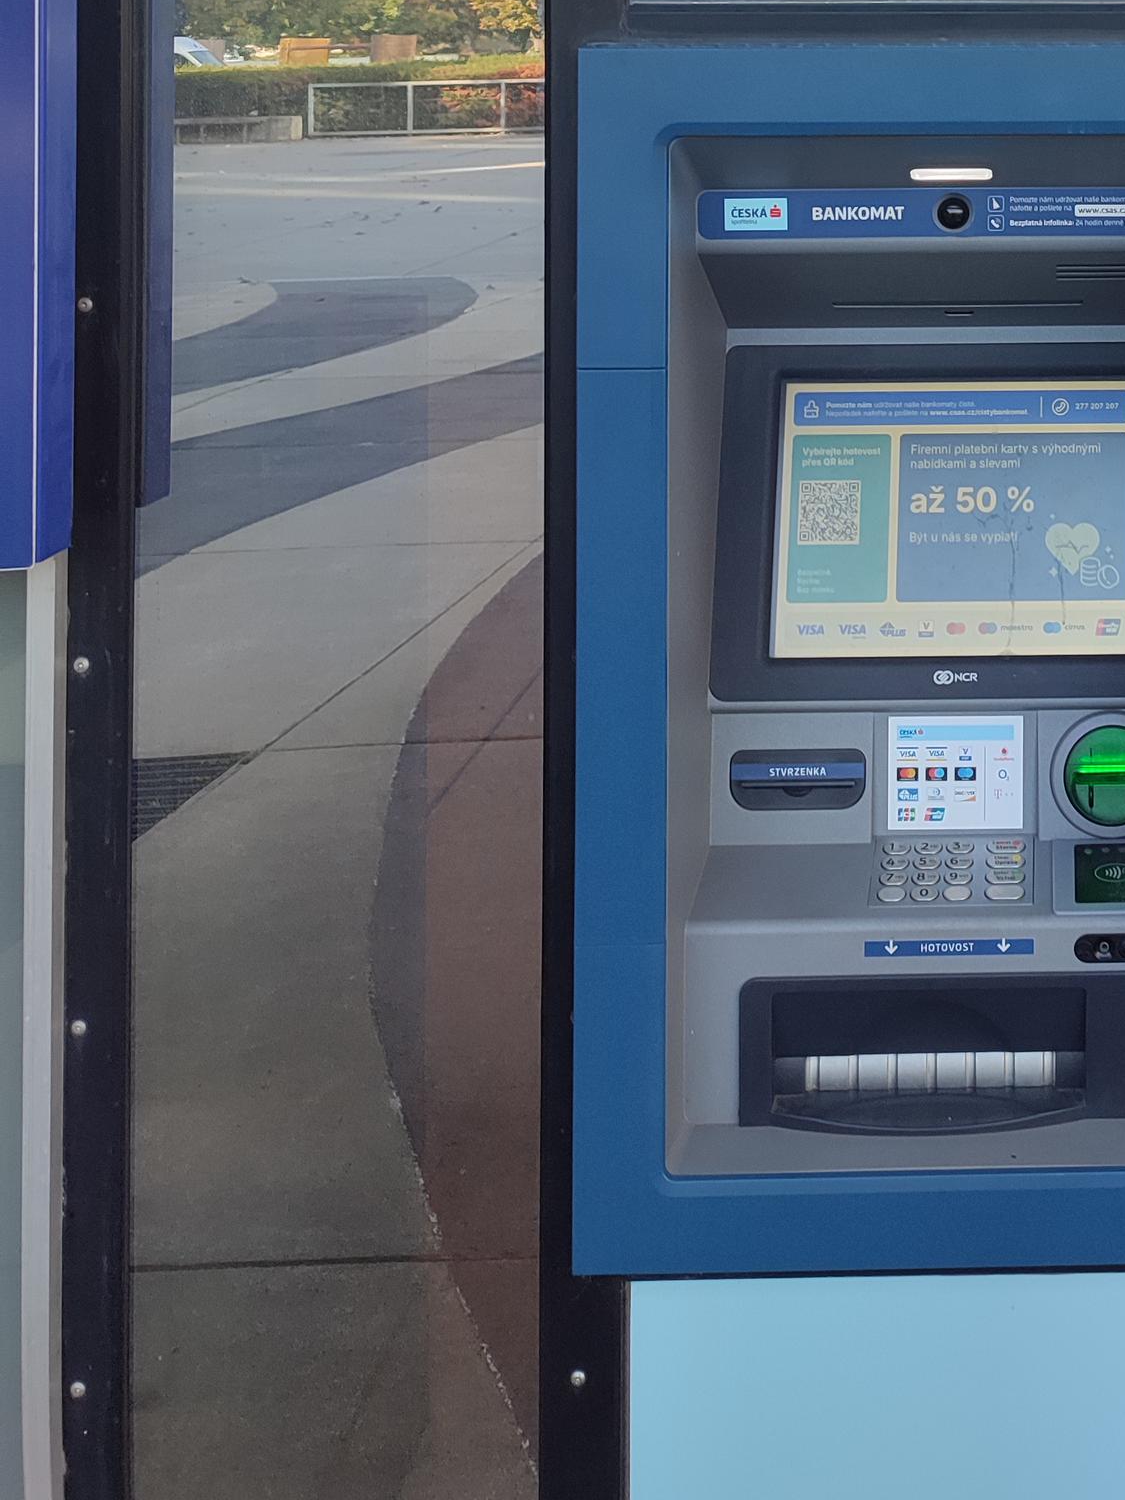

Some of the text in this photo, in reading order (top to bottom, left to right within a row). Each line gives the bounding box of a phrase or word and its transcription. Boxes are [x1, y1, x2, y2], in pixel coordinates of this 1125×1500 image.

[730, 206, 768, 218] ČESKÁ
[811, 206, 905, 221] BANKOMAT
[1090, 402, 1104, 410] 207
[1105, 402, 1120, 410] 207
[910, 442, 1101, 457] Firemní platební karty s výhodnými
[910, 457, 1021, 469] nabídkami a slevami
[910, 485, 1035, 514] až 50 %
[909, 531, 1019, 544] Být u nás se vyplatí
[797, 624, 825, 635] VISA
[839, 624, 867, 635] VISA
[954, 672, 979, 683] NCR
[768, 766, 827, 777] STVRZENKA
[920, 842, 929, 850] 2
[952, 841, 961, 850] 3
[886, 858, 895, 866] 4
[919, 857, 927, 866] 5
[950, 857, 959, 865] 6
[886, 873, 895, 881] 7
[916, 873, 925, 881] 8
[950, 872, 958, 880] 9
[920, 888, 929, 897] 0
[920, 942, 974, 953] HOTOVOST
